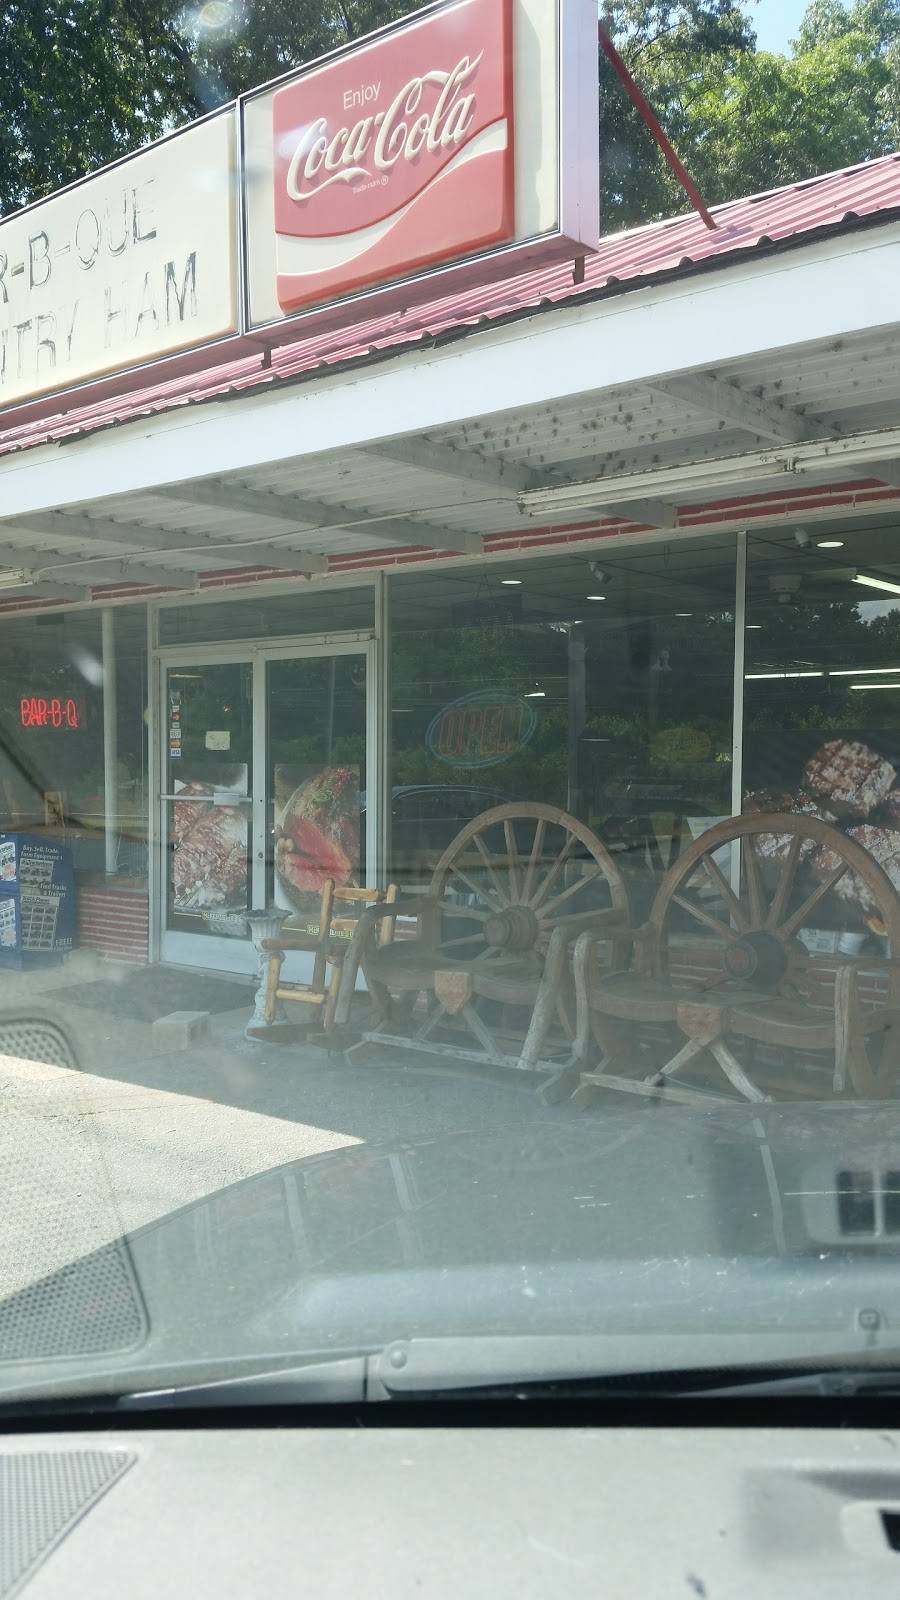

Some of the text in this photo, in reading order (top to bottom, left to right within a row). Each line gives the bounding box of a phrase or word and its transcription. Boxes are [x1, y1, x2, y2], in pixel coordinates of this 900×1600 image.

[287, 48, 484, 200] Coca-Cola
[343, 81, 381, 110] Enjoy
[104, 251, 198, 349] HAM
[20, 697, 78, 728] BAR-B-Q
